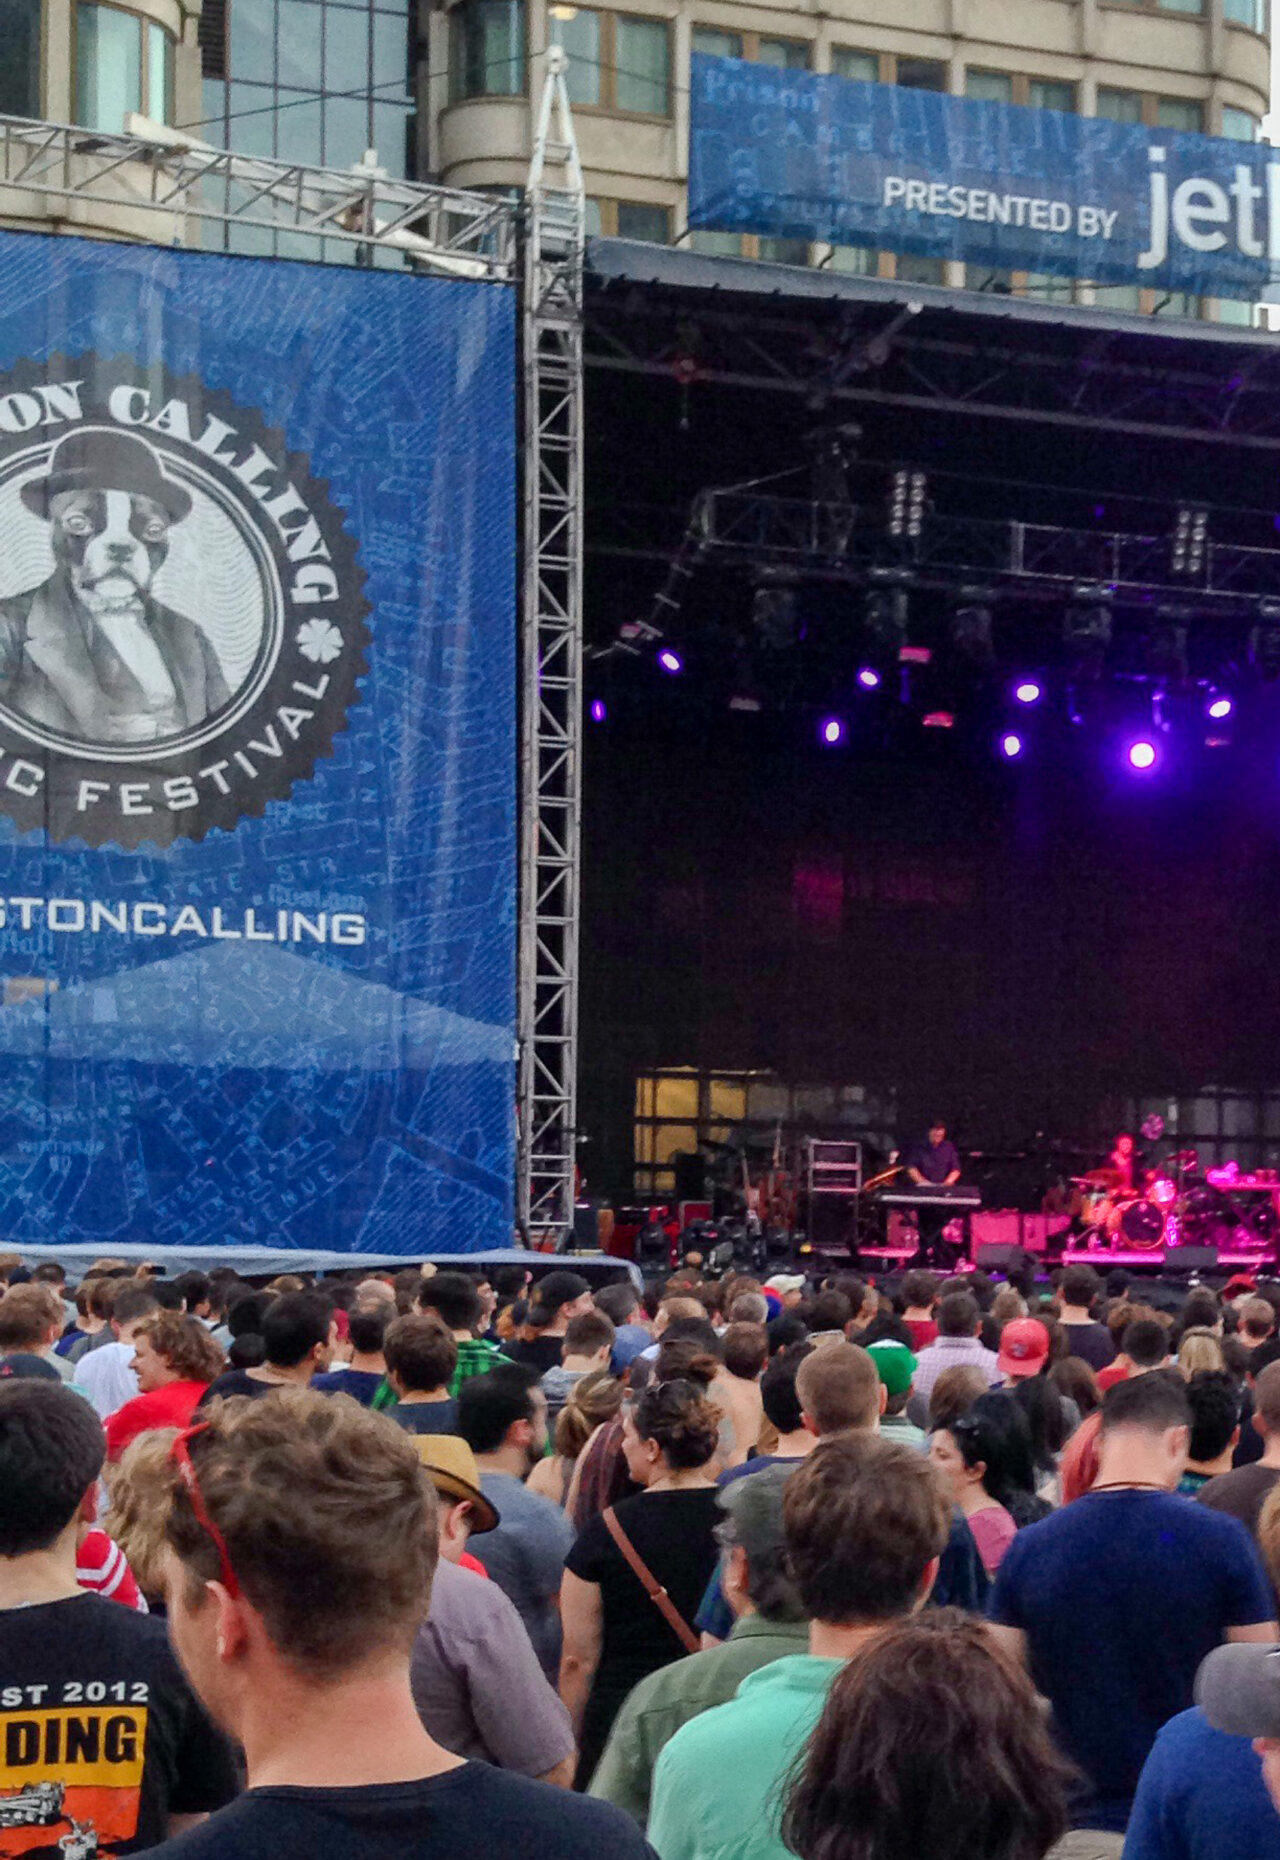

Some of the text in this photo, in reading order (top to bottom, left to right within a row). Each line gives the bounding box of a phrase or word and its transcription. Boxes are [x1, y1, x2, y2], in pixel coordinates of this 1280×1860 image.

[883, 176, 1119, 239] PRESENTED BY
[108, 384, 340, 604] CALLING
[77, 673, 331, 816] FESTIVAL
[0, 896, 366, 946] TONCALLING
[1, 1681, 150, 1707] ST 2012
[6, 1715, 137, 1767] DING
